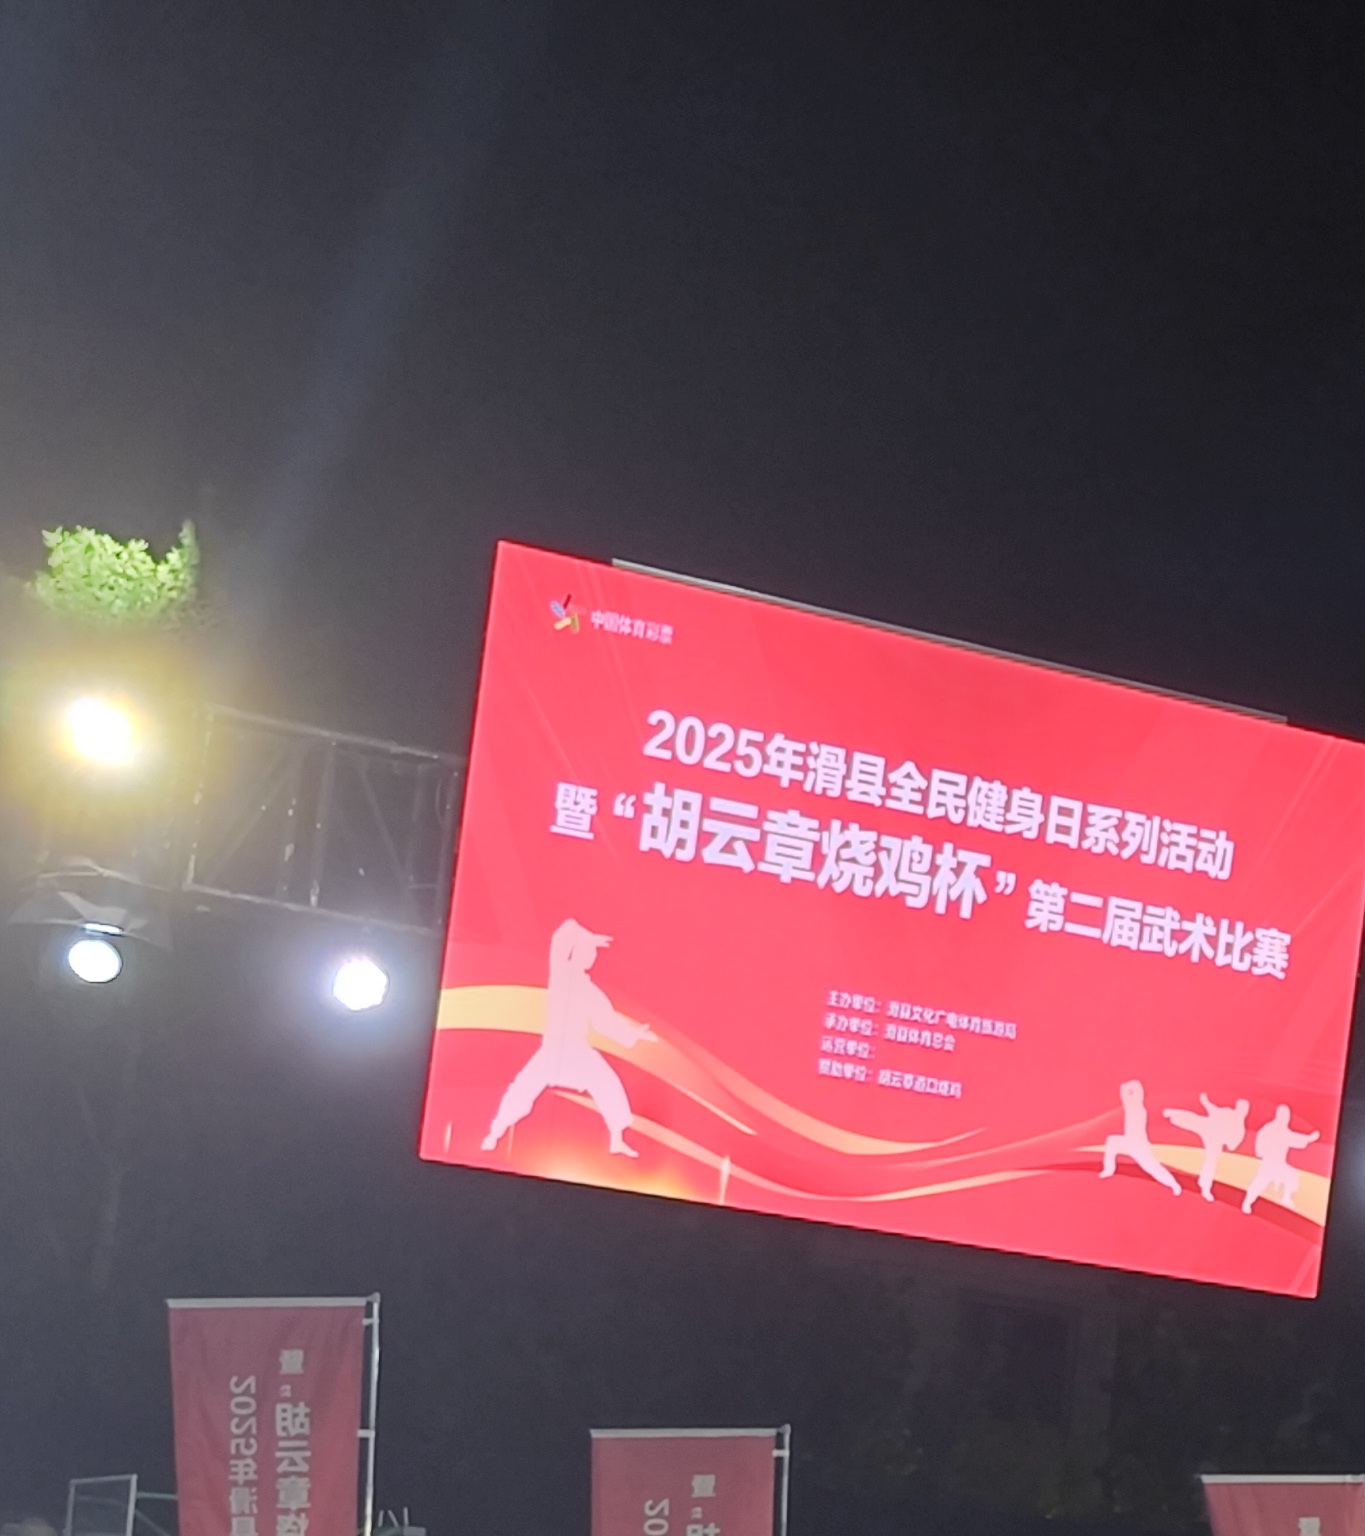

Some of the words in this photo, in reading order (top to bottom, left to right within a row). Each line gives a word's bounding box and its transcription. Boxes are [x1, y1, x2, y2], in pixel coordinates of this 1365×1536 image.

[643, 709, 1235, 881] 2025年滑县全民健身日系列活动
